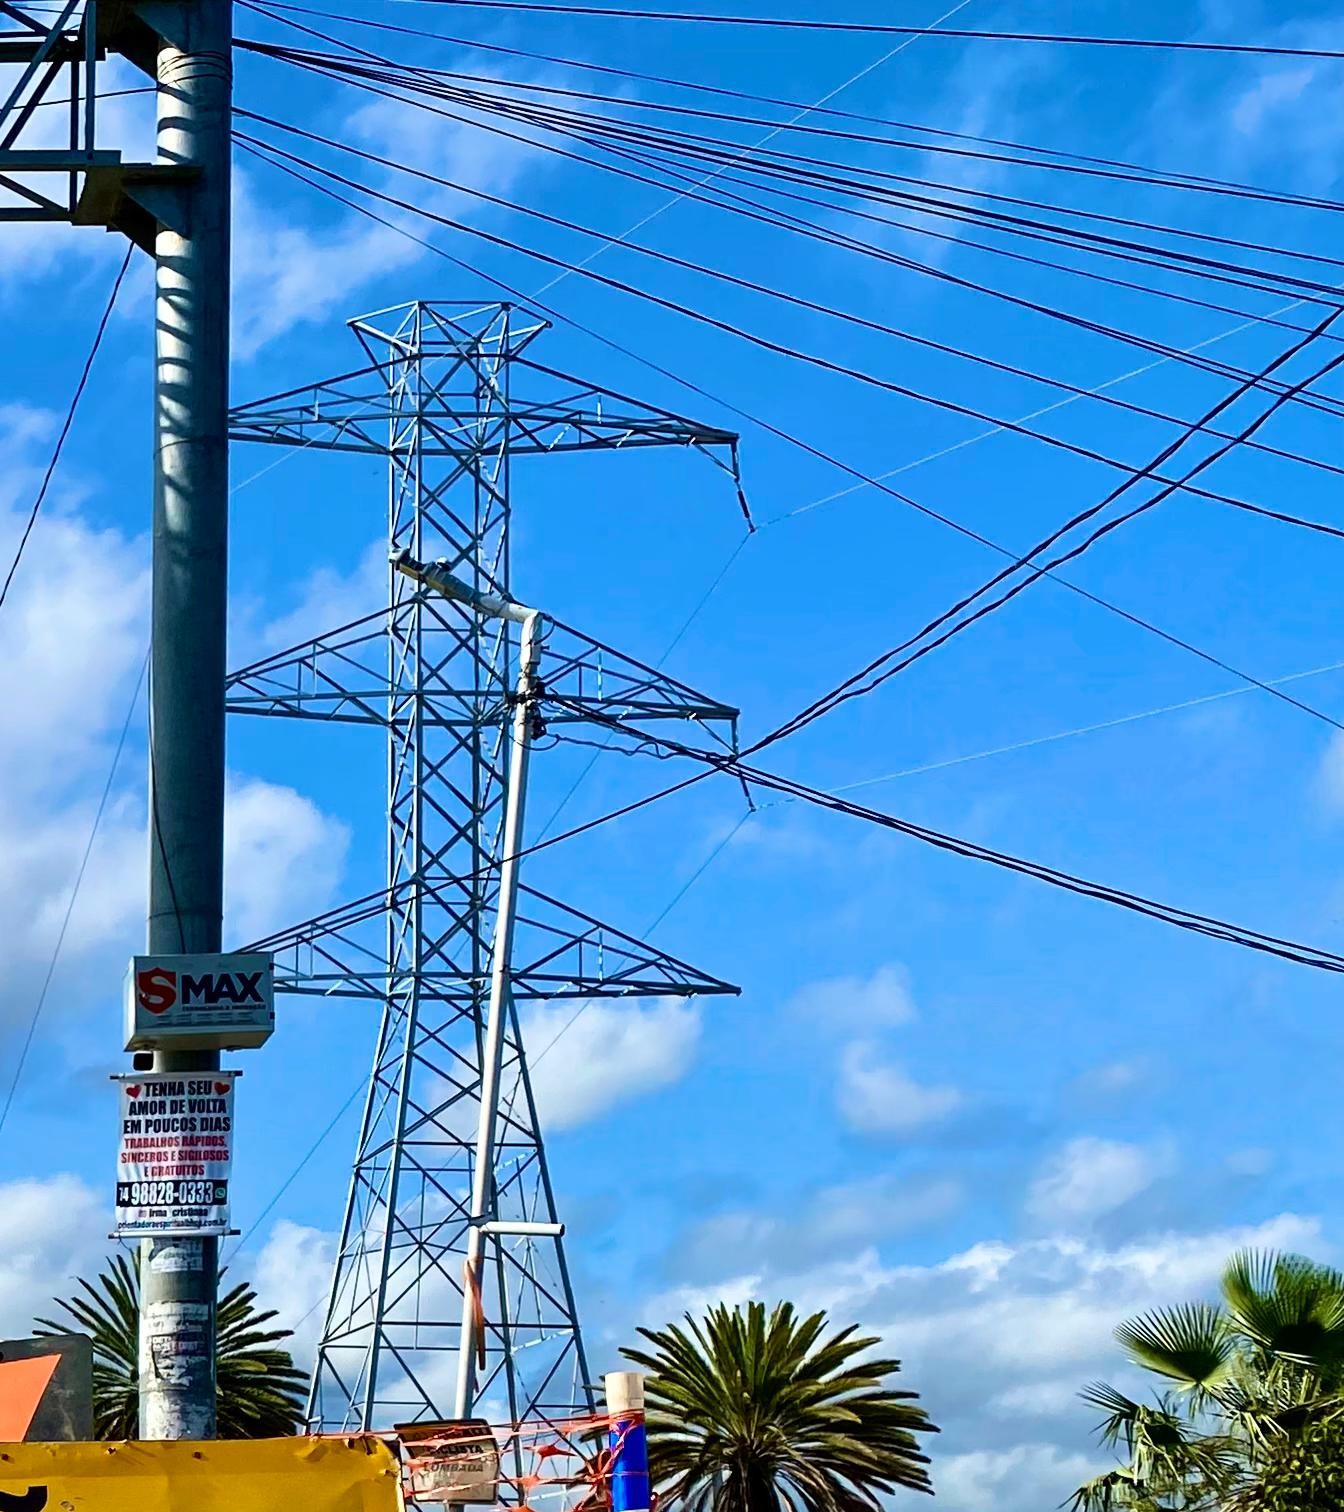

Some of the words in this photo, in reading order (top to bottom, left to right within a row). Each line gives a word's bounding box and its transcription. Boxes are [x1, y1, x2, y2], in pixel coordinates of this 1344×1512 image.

[144, 1081, 185, 1097] TENHA
[188, 1080, 212, 1095] SEU
[128, 1100, 166, 1116] AMOR
[170, 1100, 186, 1114] DE
[188, 1098, 227, 1114] VOLTA
[123, 1119, 141, 1134] EM
[145, 1117, 197, 1133] POUCOS
[200, 1116, 231, 1132] DIAS
[124, 1136, 180, 1149] TRABALHOS
[121, 1151, 169, 1163] SINCEROS
[171, 1151, 176, 1162] E
[178, 1149, 229, 1162] SIGILOSOS
[144, 1166, 149, 1177] E
[151, 1165, 205, 1177] GRATUITOS
[131, 1181, 213, 1205] 98828-0333
